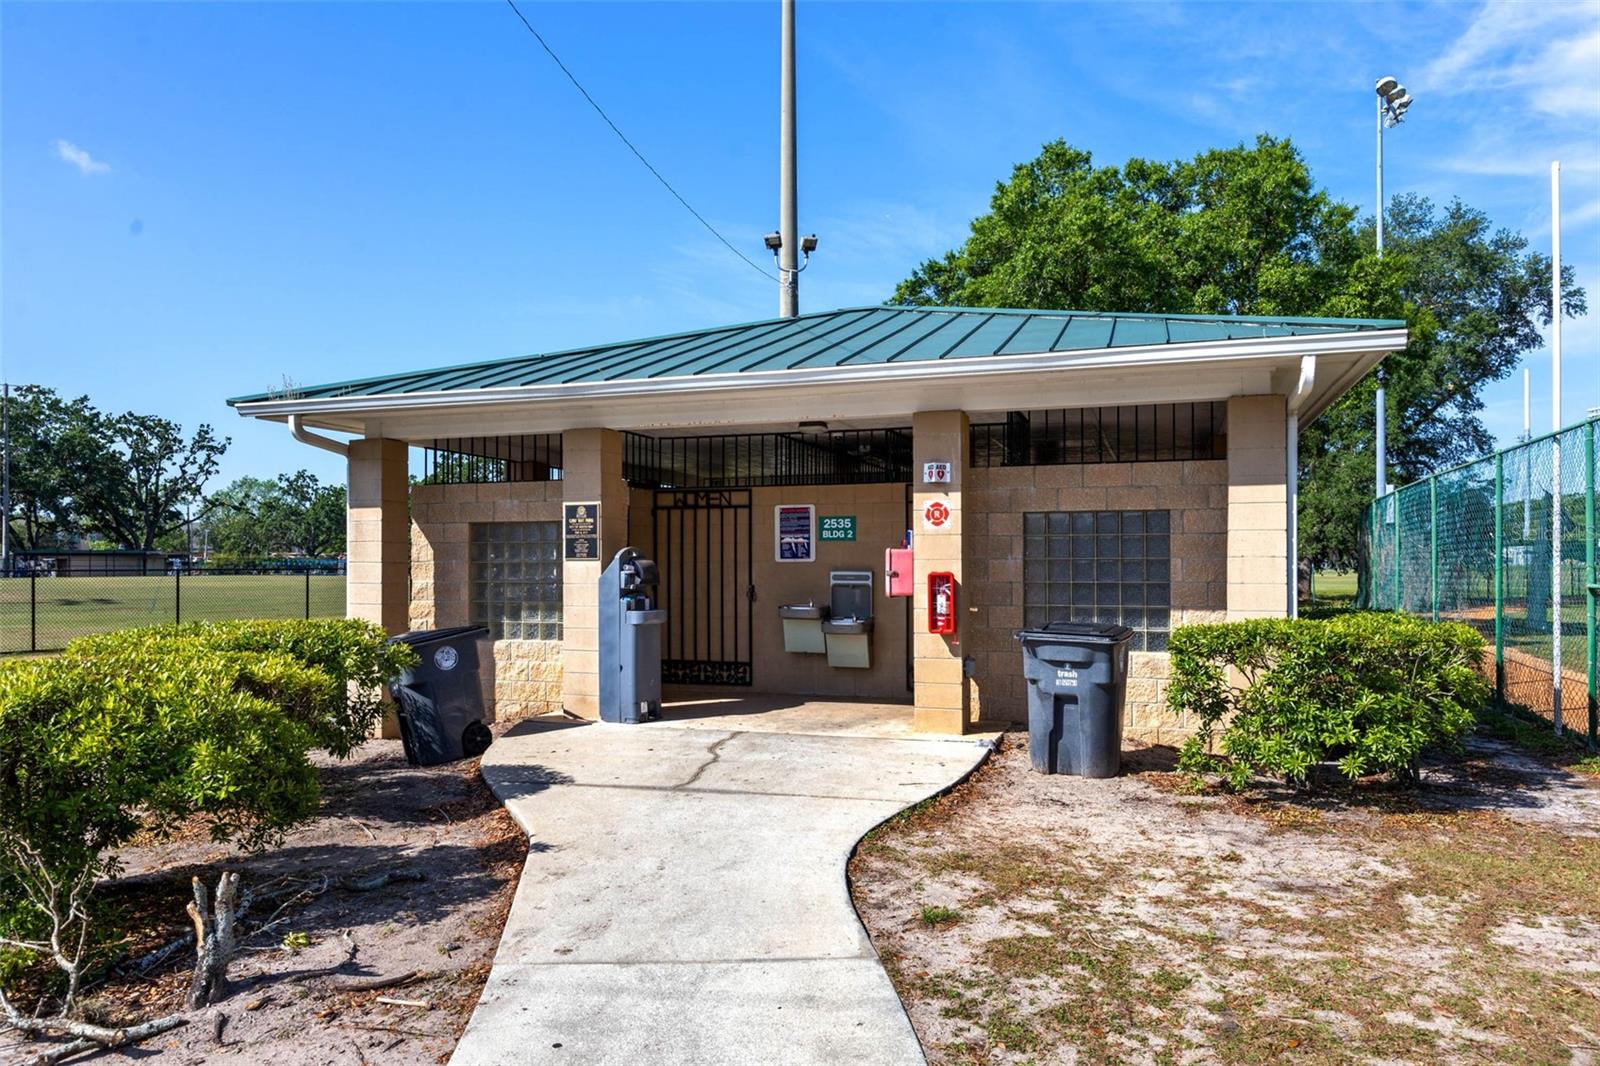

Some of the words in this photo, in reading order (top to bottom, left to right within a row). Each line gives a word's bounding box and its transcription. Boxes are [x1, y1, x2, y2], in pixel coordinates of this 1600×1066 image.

[673, 491, 732, 507] WOMEN
[934, 510, 940, 518] R
[823, 518, 852, 528] 2535
[822, 530, 845, 538] BLDG
[846, 530, 853, 538] 2
[1057, 669, 1078, 678] trash
